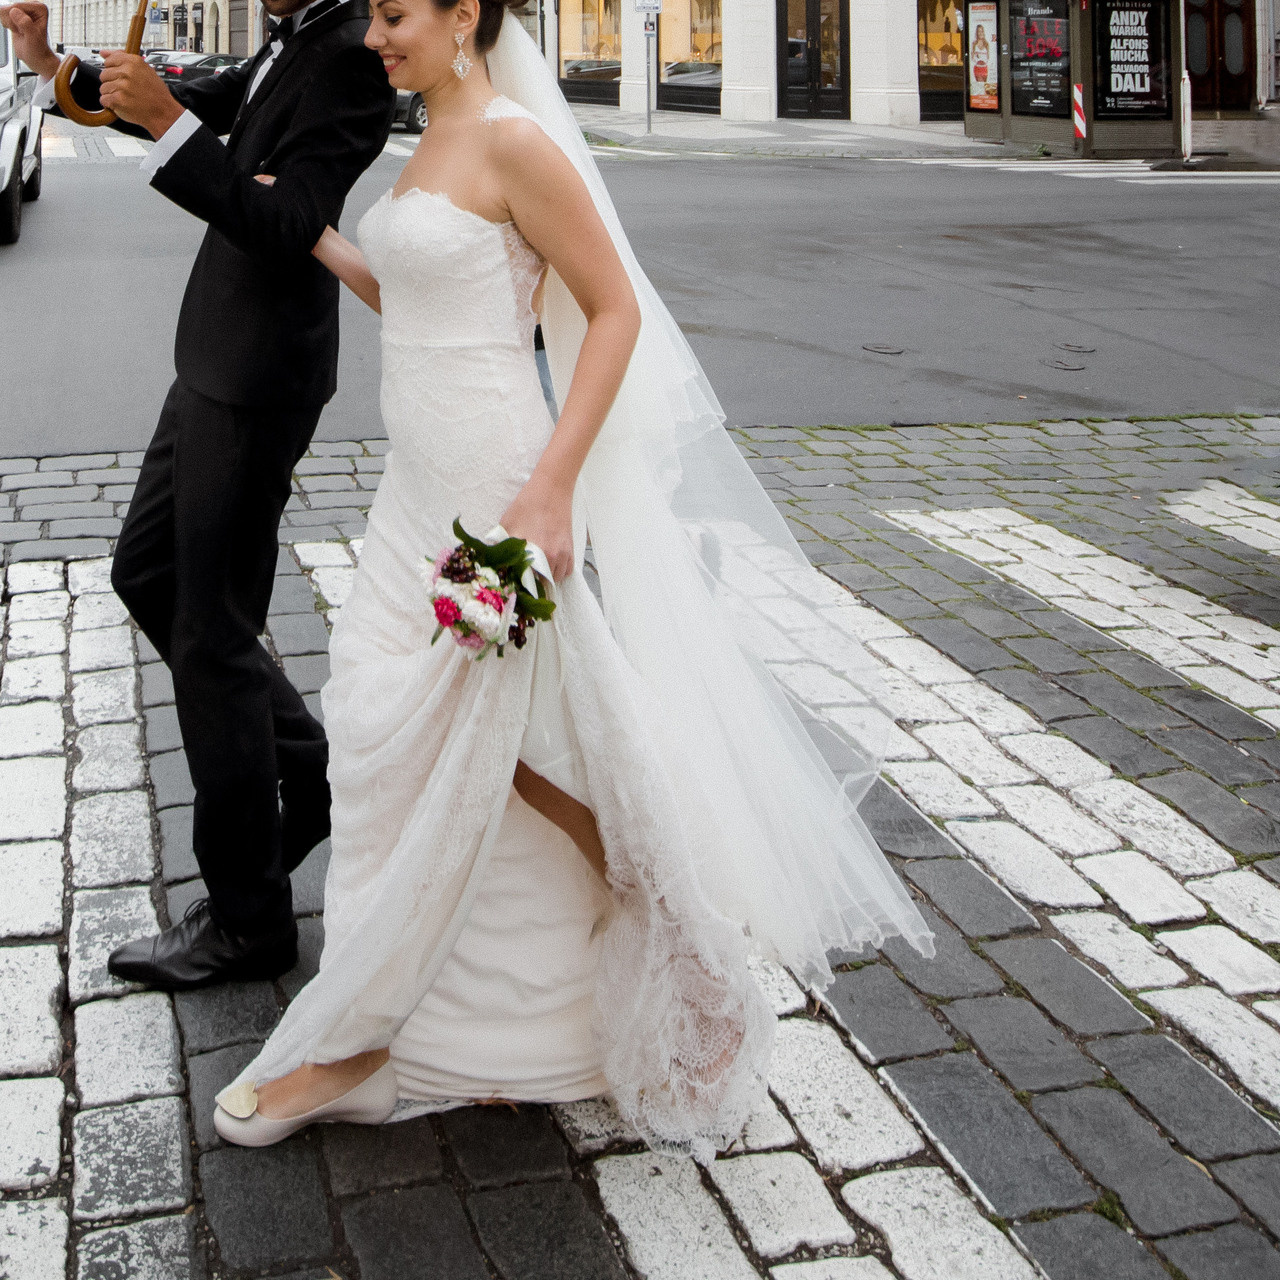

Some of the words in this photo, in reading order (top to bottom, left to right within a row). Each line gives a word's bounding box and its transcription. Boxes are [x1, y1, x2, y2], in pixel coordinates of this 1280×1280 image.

[1106, 0, 1152, 8] exhibition
[1110, 11, 1148, 26] ANDY
[1019, 19, 1063, 35] SALE
[1110, 26, 1149, 36] WARHOL
[1026, 38, 1063, 58] 50%
[1110, 39, 1149, 50] ALFONS
[1110, 50, 1149, 61] MUCHA
[1111, 64, 1150, 73] SALVADOR
